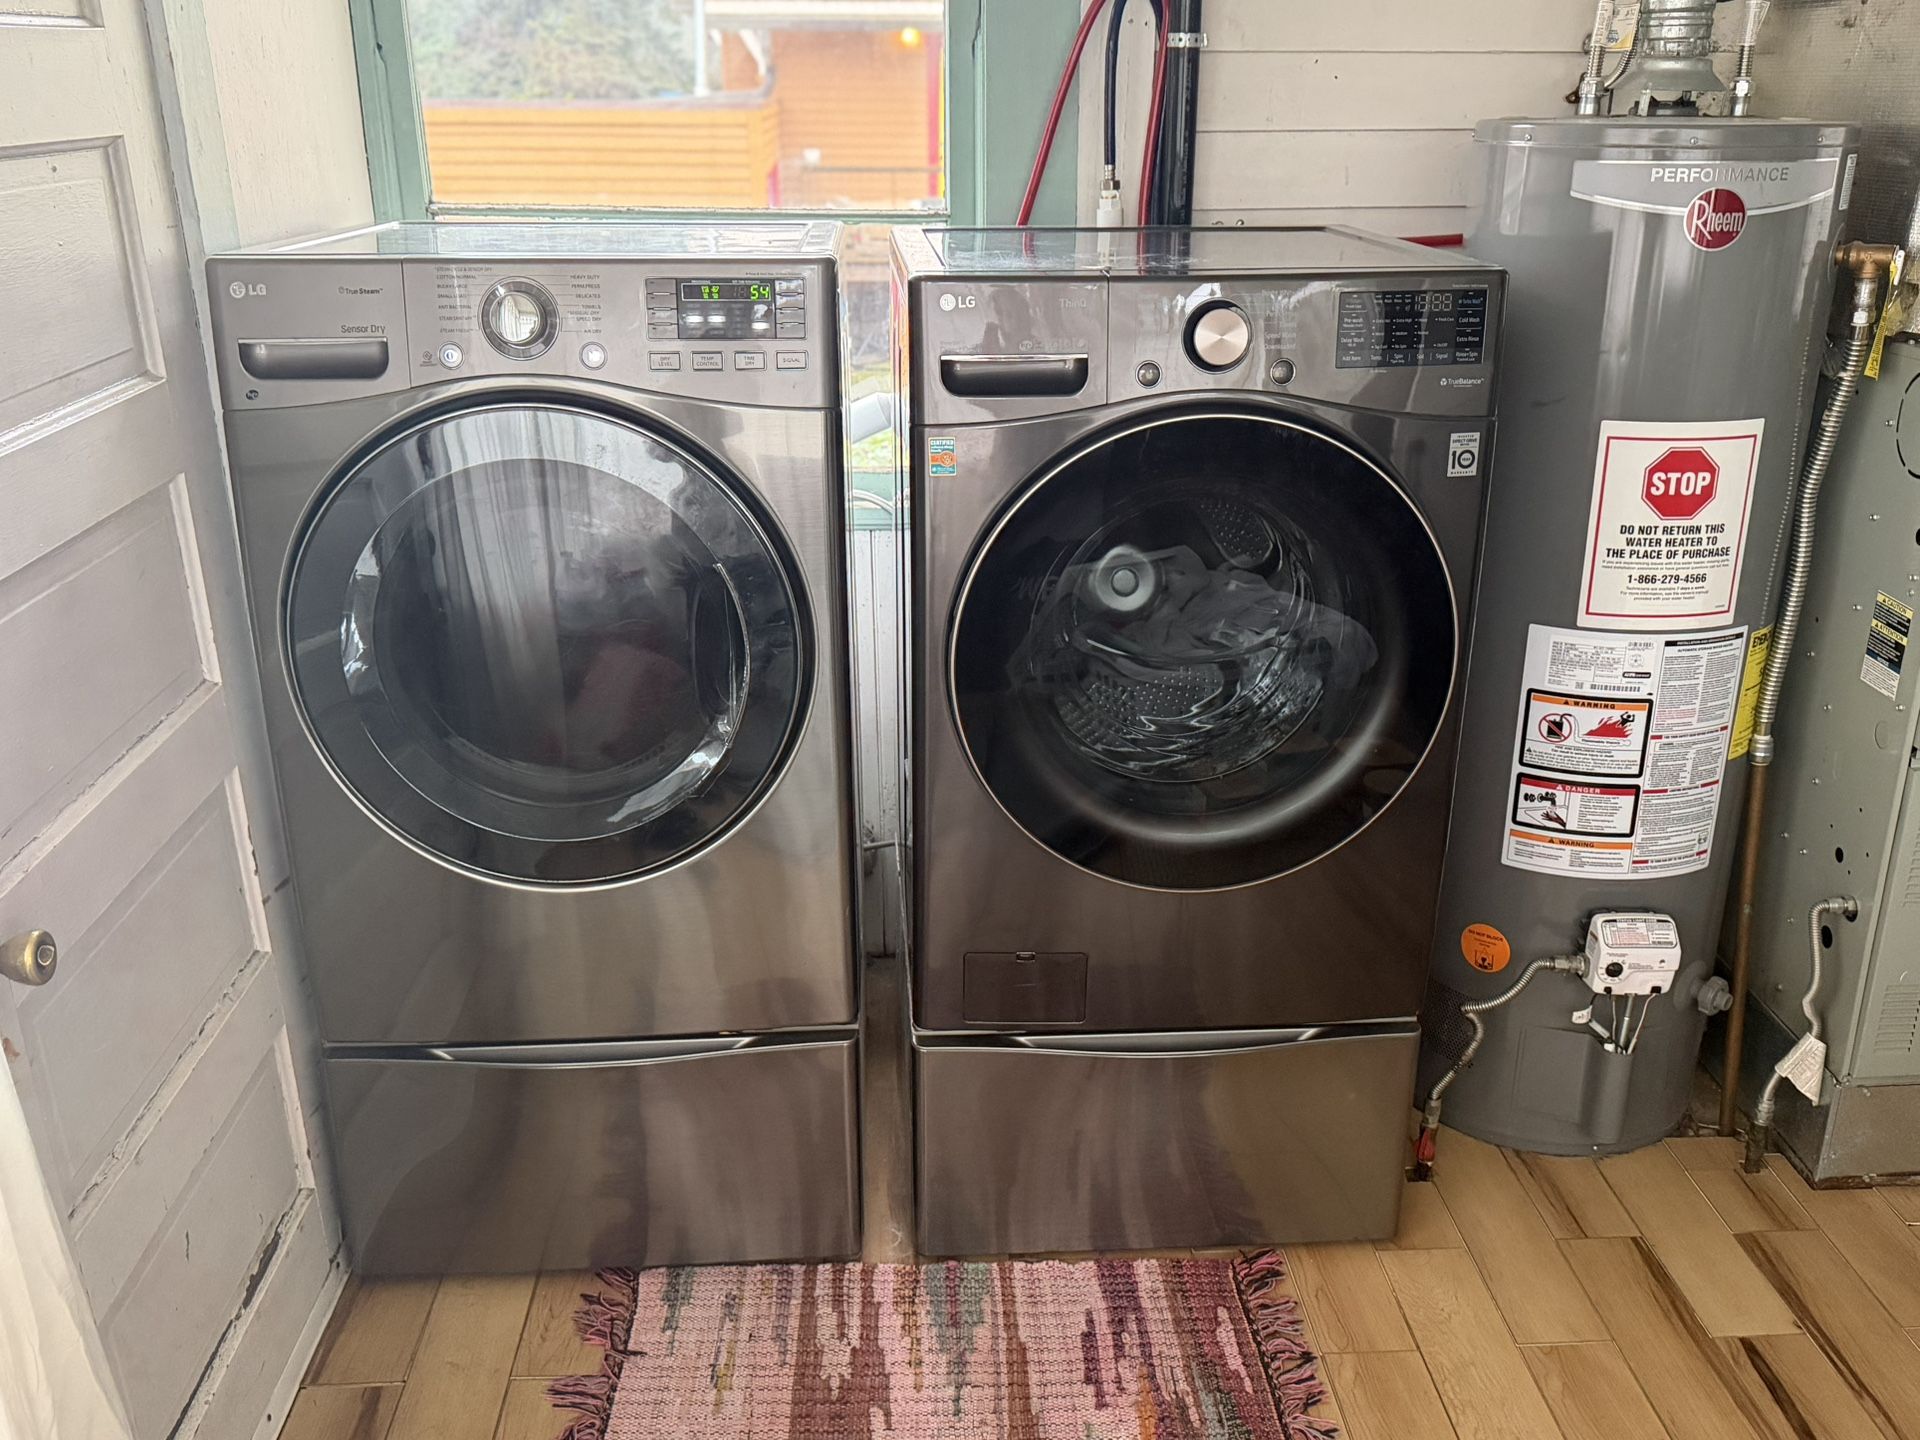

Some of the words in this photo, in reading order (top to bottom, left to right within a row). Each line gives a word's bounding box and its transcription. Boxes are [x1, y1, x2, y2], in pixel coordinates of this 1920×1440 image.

[1690, 188, 1744, 240] Rheem
[248, 283, 268, 297] LG
[750, 285, 770, 300] 54
[957, 295, 976, 309] LG
[340, 324, 368, 333] Sensor
[370, 323, 387, 335] Dry
[1451, 449, 1475, 469] 10
[1650, 471, 1712, 496] STOP
[1620, 524, 1635, 535] DO
[1638, 525, 1659, 535] NOT
[1662, 525, 1702, 535] RETURN
[1705, 523, 1726, 534] THIS
[1625, 537, 1662, 547] WATER
[1665, 536, 1703, 547] HEATER
[1706, 536, 1718, 546] TO
[1606, 548, 1626, 559] THE
[1629, 549, 1662, 560] PLACE
[1666, 548, 1679, 559] OF
[1682, 546, 1731, 559] PURCHASE
[1627, 573, 1708, 584] 1-866-279-4566
[1886, 597, 1908, 615] CAUTION
[1879, 624, 1904, 643] ATTENTION
[1573, 700, 1616, 710] WARNING
[1565, 785, 1601, 794] DANGER
[1558, 839, 1595, 848] WARNING
